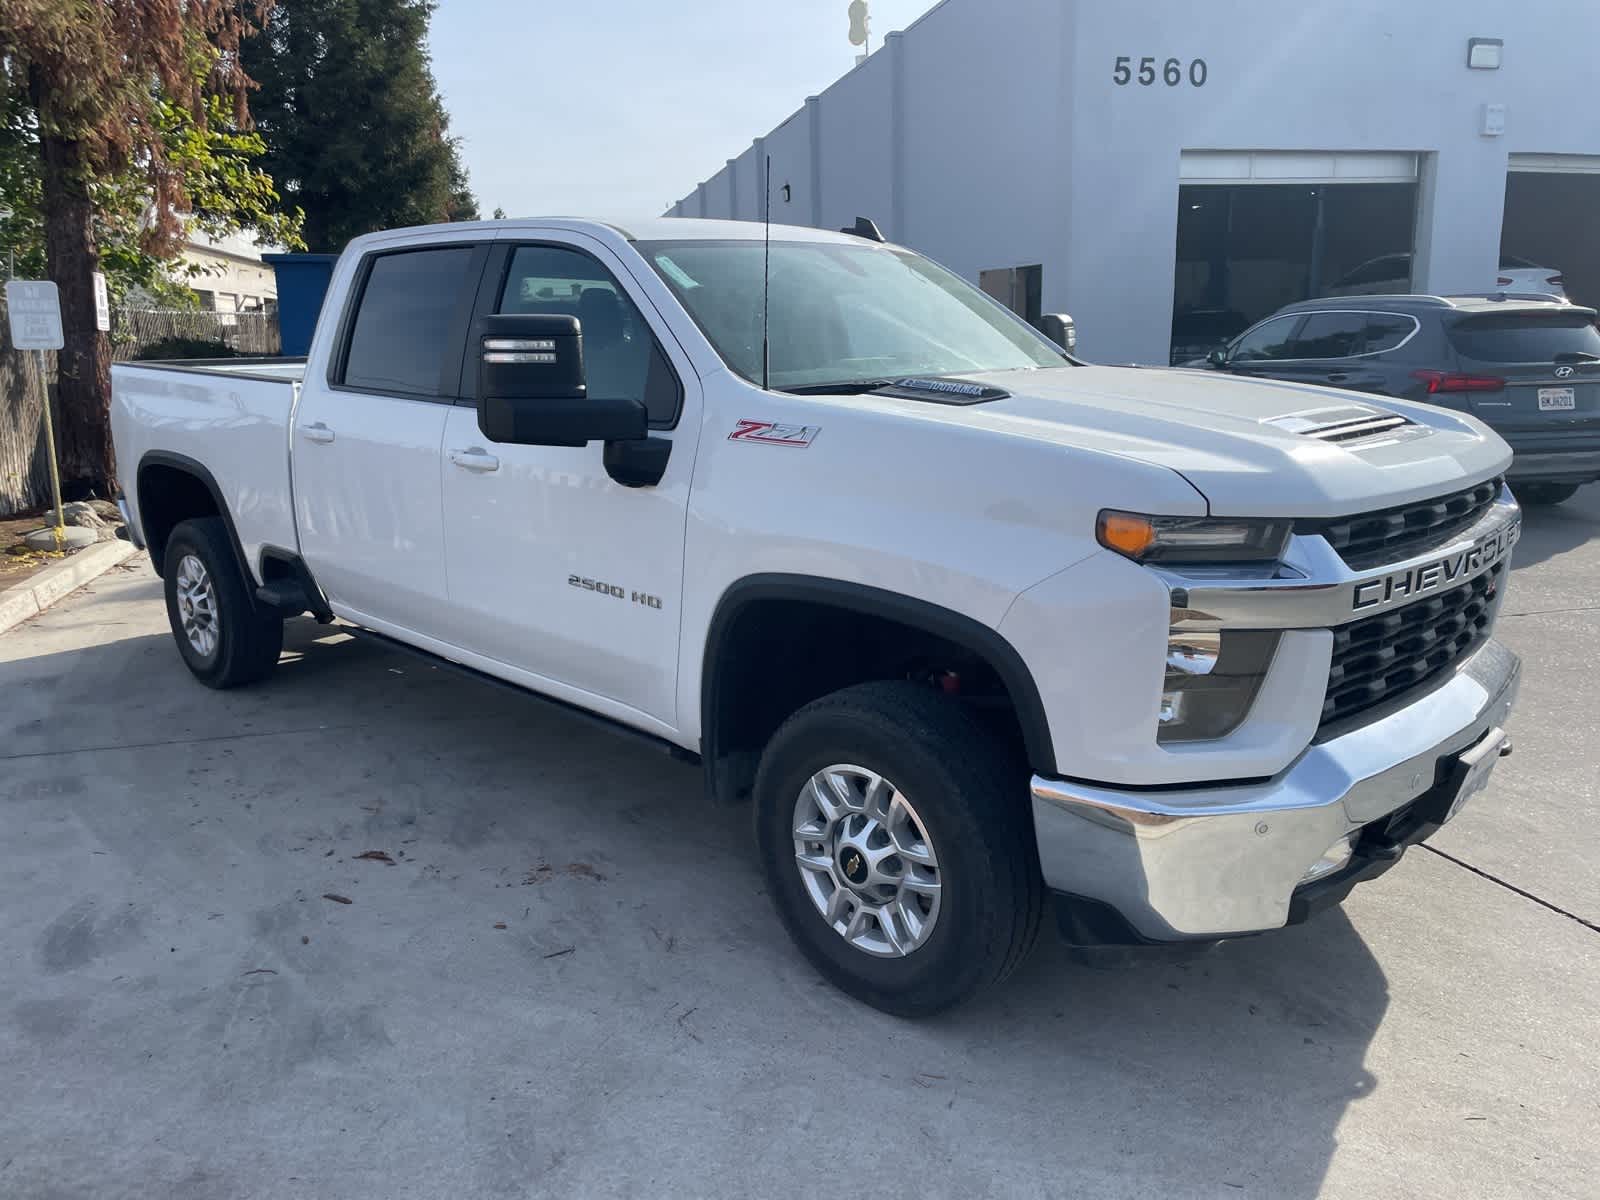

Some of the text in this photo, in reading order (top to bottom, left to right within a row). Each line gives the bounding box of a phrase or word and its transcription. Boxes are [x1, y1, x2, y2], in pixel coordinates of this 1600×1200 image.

[1112, 56, 1208, 88] 5560
[727, 418, 822, 449] Z71
[567, 573, 663, 610] 2500 HD
